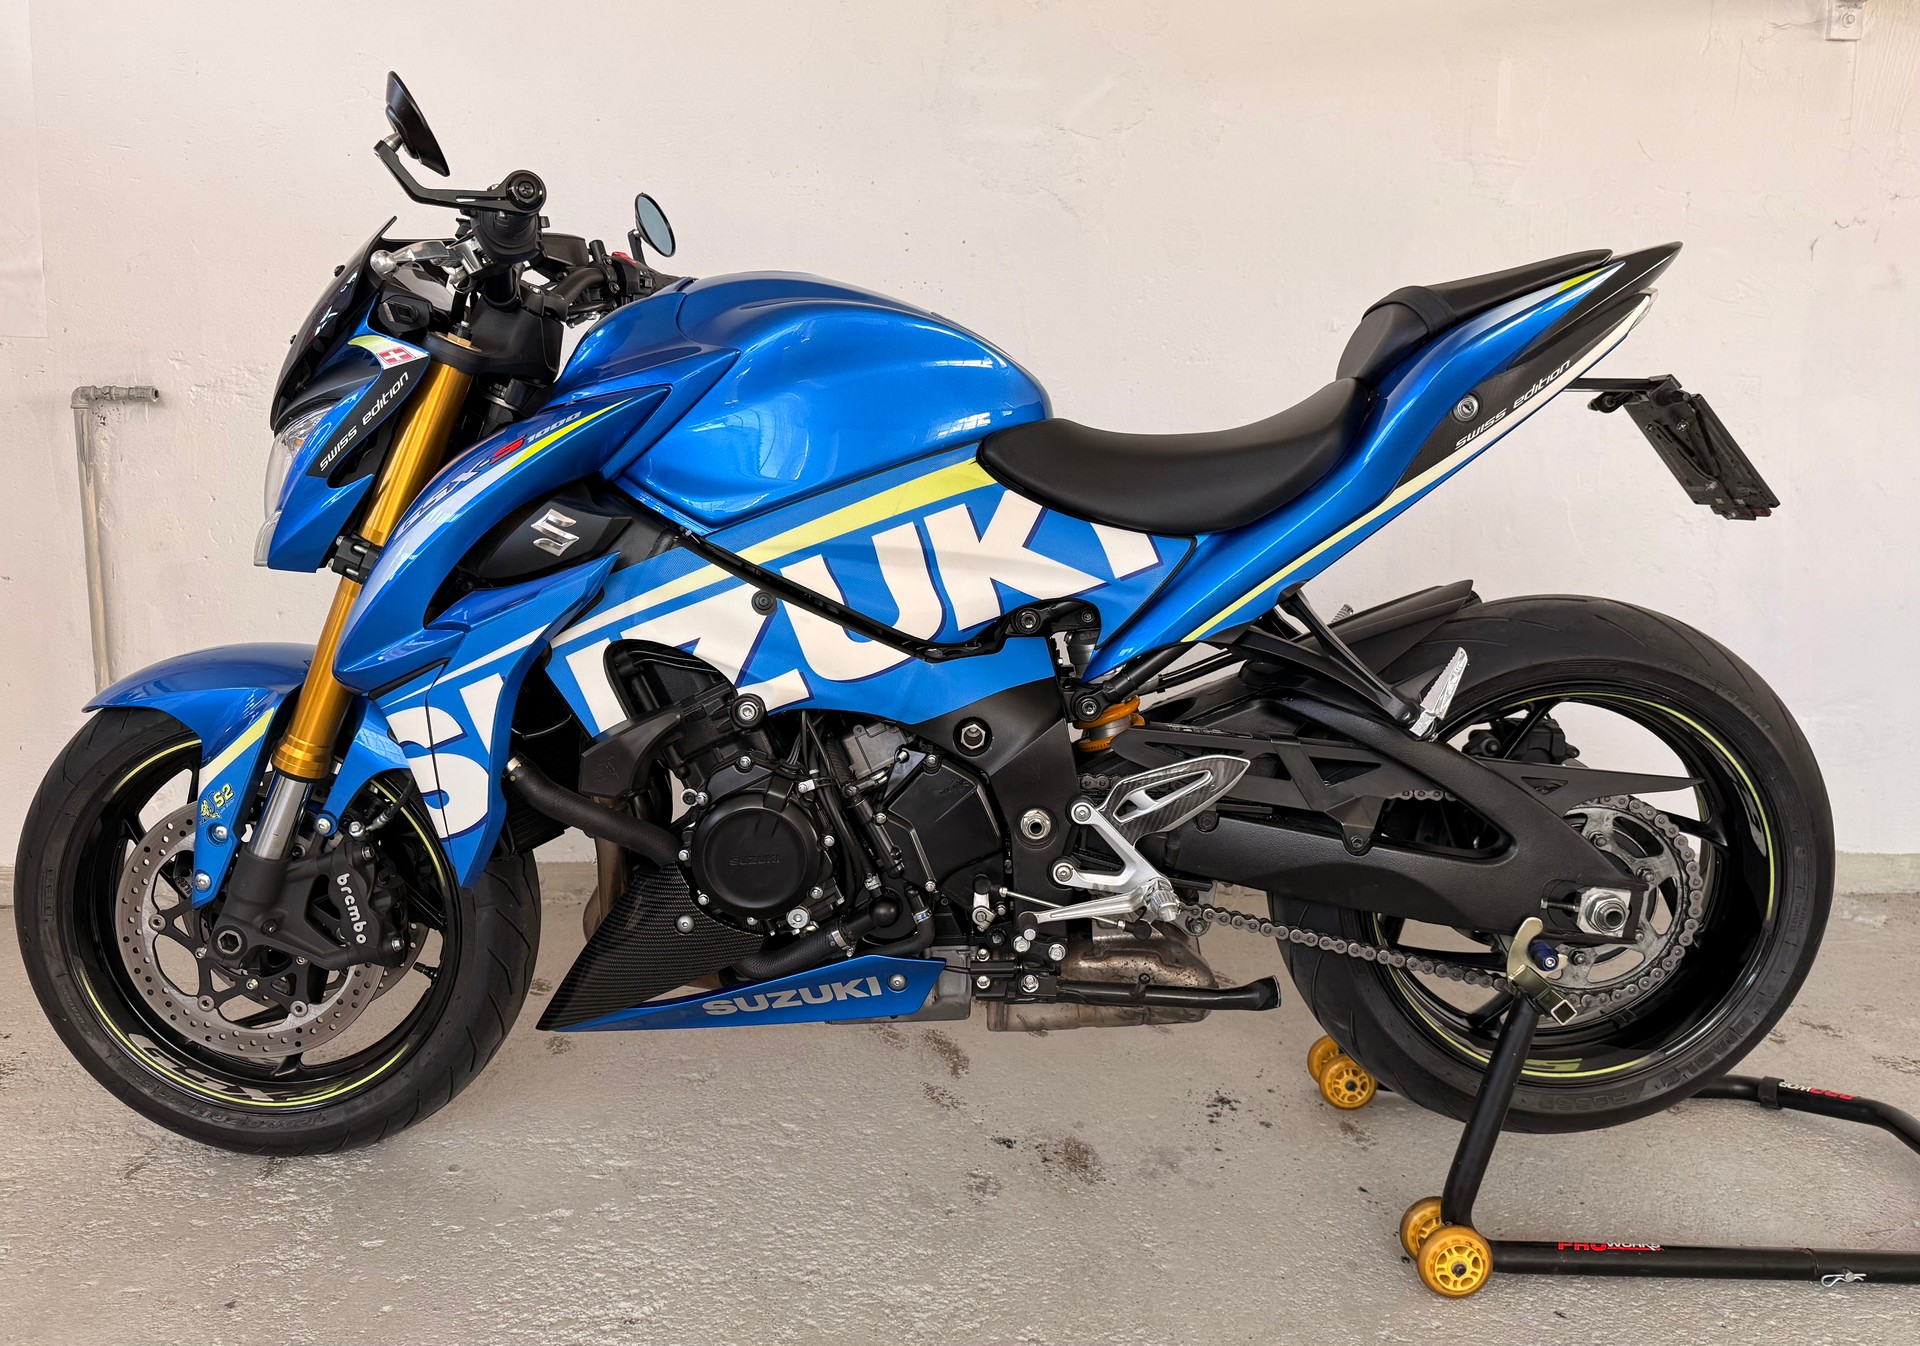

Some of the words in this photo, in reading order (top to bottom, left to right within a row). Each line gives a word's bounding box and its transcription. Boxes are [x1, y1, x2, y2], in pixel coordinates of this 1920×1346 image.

[320, 425, 358, 471] swiss
[362, 371, 409, 425] edition
[1455, 408, 1507, 450] swiss
[1513, 360, 1570, 409] edition
[728, 854, 781, 867] SUZUKI
[701, 976, 882, 1016] SUZUKI
